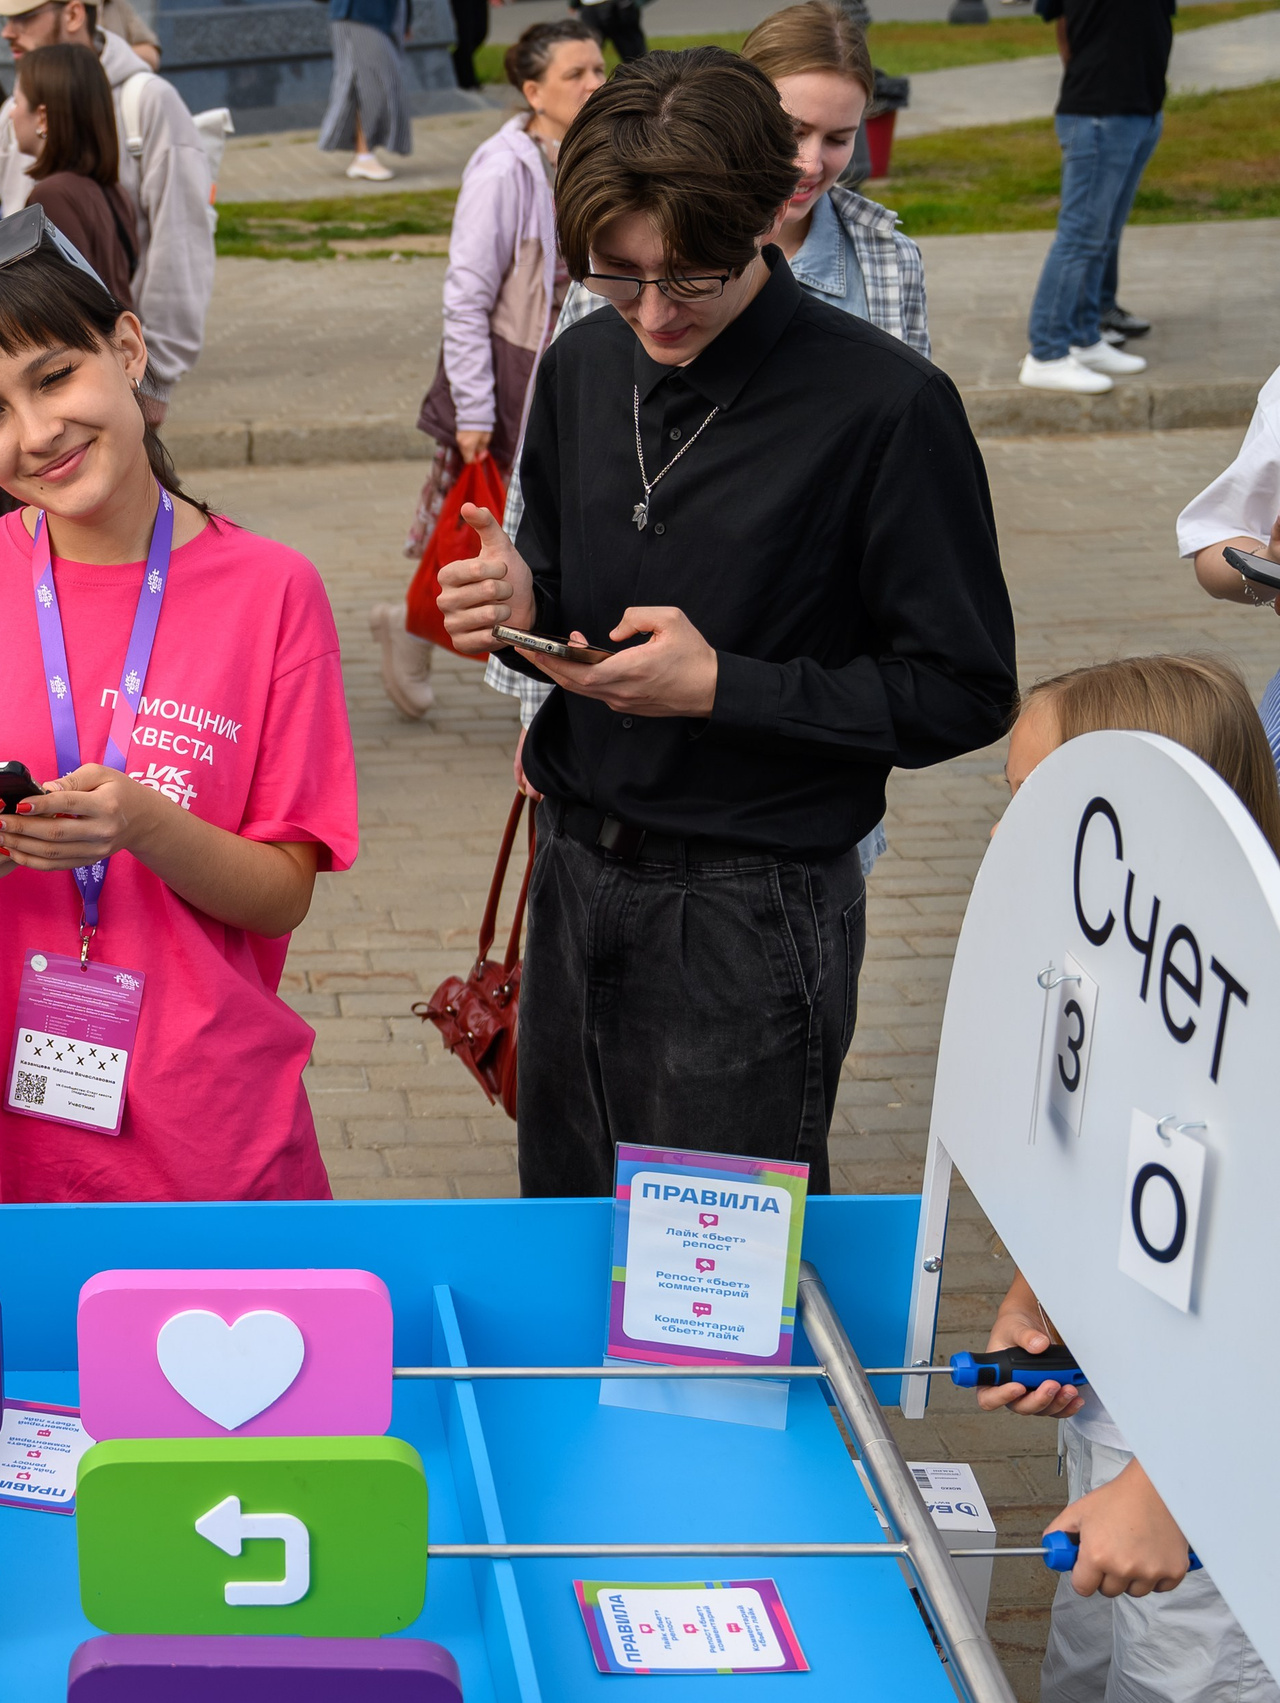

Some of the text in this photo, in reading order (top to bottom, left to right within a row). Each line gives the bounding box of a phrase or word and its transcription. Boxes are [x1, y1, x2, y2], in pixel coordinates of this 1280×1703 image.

[100, 688, 243, 744] ПМОЩНИК
[146, 762, 192, 787] VK
[1073, 796, 1249, 1084] Счет
[1057, 998, 1086, 1093] 3
[642, 1183, 780, 1214] ПРАВИЛА
[666, 1227, 746, 1244] Лайк «бьет»
[682, 1240, 732, 1252] репост
[656, 1271, 750, 1289] Репост «бьет»
[658, 1281, 749, 1298] комментарий
[654, 1314, 745, 1333] Комментарий
[661, 1325, 740, 1341] «бьет» лайк
[609, 1594, 643, 1663] ПРАВИЛА
